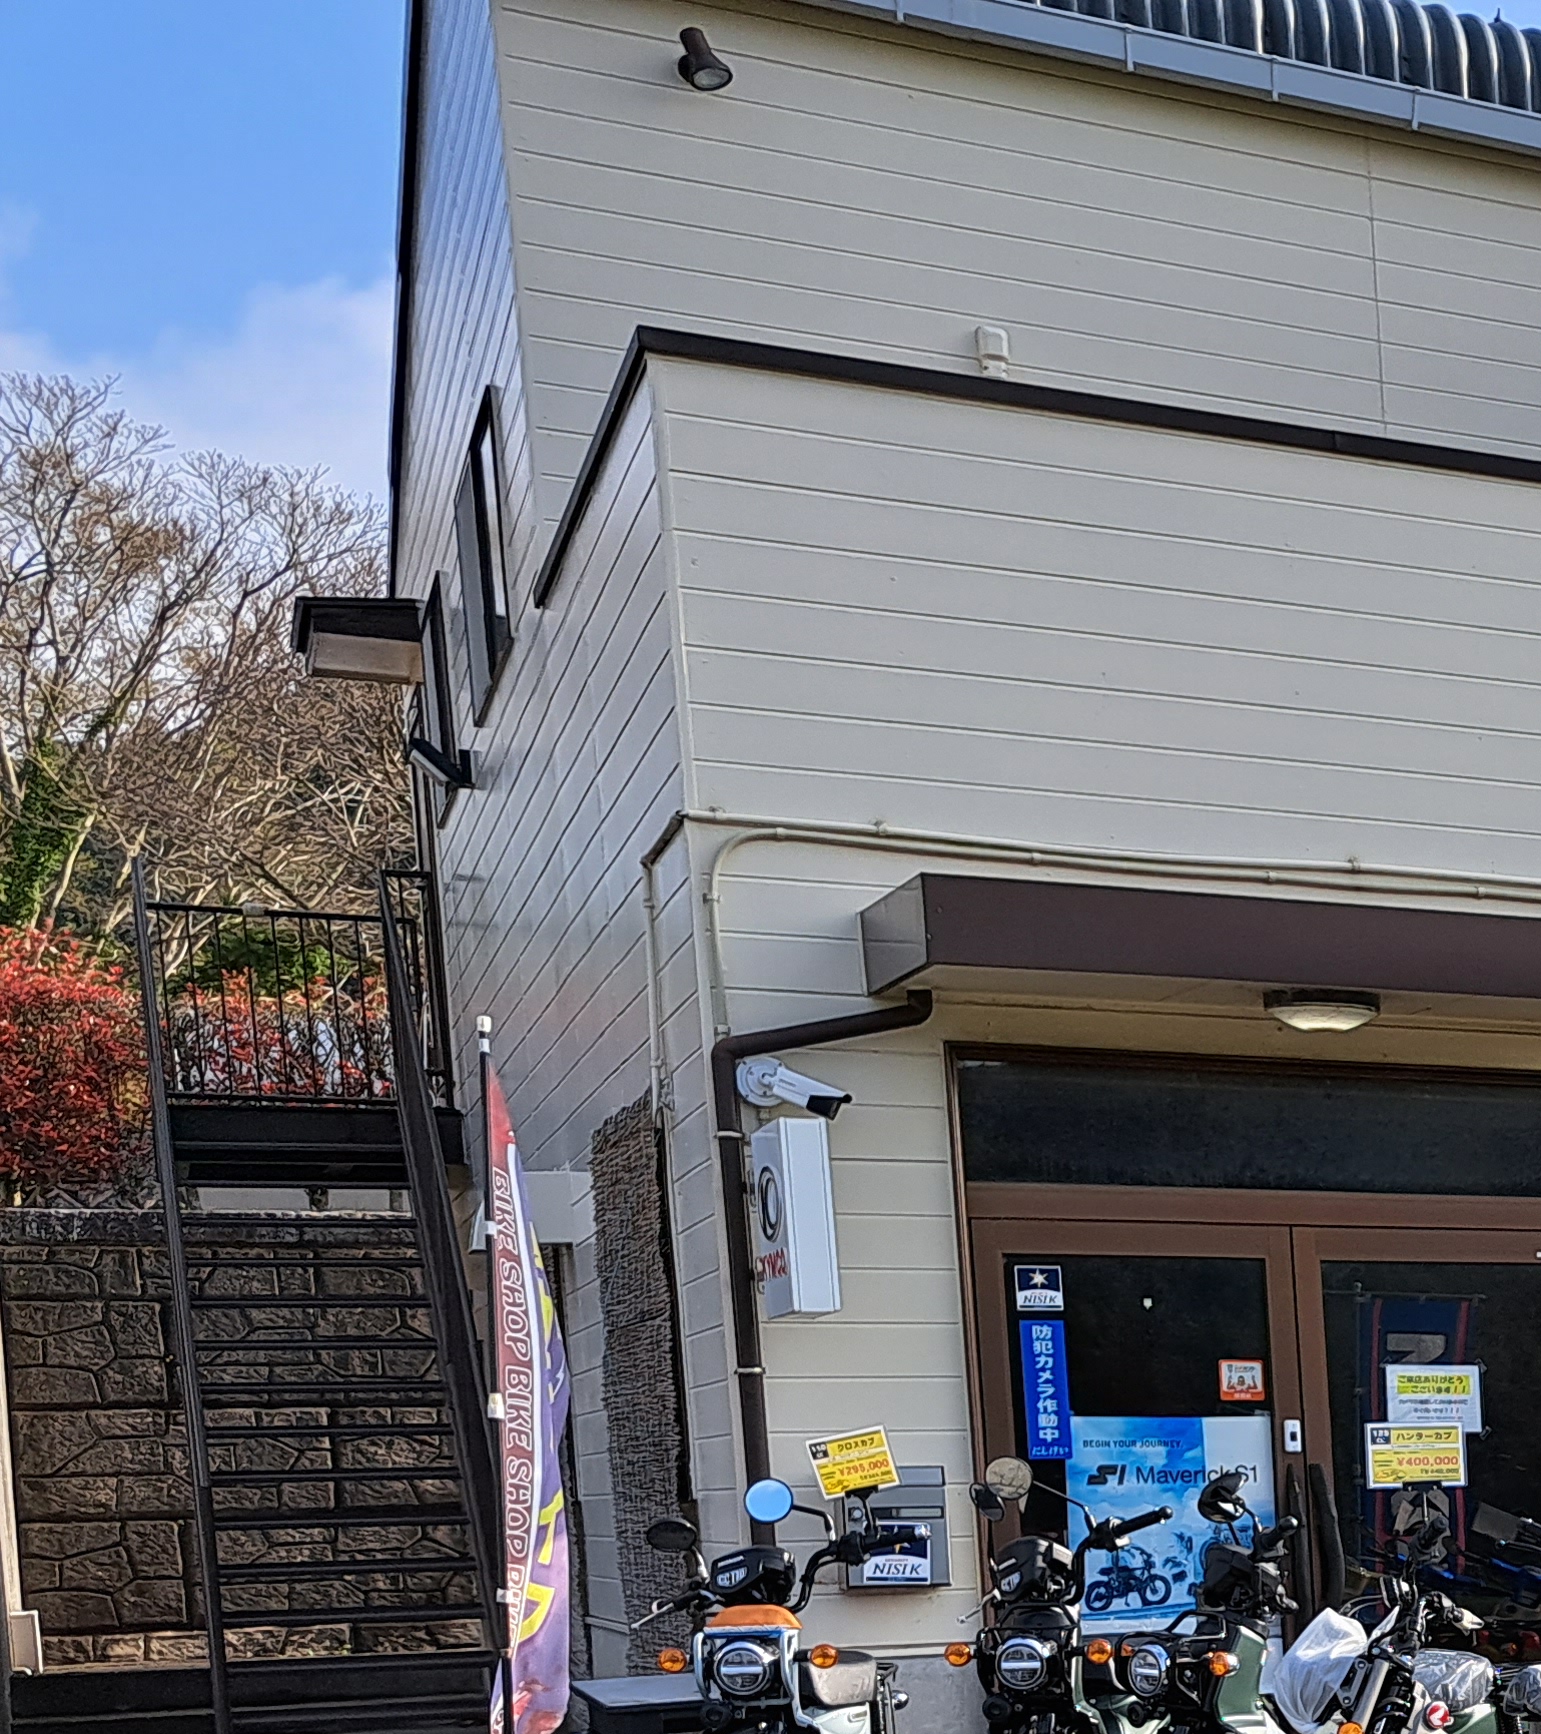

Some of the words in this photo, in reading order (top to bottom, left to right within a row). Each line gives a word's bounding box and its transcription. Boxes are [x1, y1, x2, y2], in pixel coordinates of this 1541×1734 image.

[492, 1166, 519, 1257] BIKE
[500, 1257, 531, 1361] SHOP
[505, 1365, 533, 1450] BIKE
[1031, 1324, 1060, 1443] 防犯カメラ作動中
[837, 1437, 875, 1452] クロスカブ
[1083, 1439, 1111, 1449] BEGIN
[1112, 1439, 1137, 1449] YOUR
[1396, 1431, 1453, 1441] ハンターカブ
[1397, 1456, 1459, 1467] ¥400,000
[506, 1456, 533, 1558] SHOP
[873, 1562, 923, 1576] NISIK
